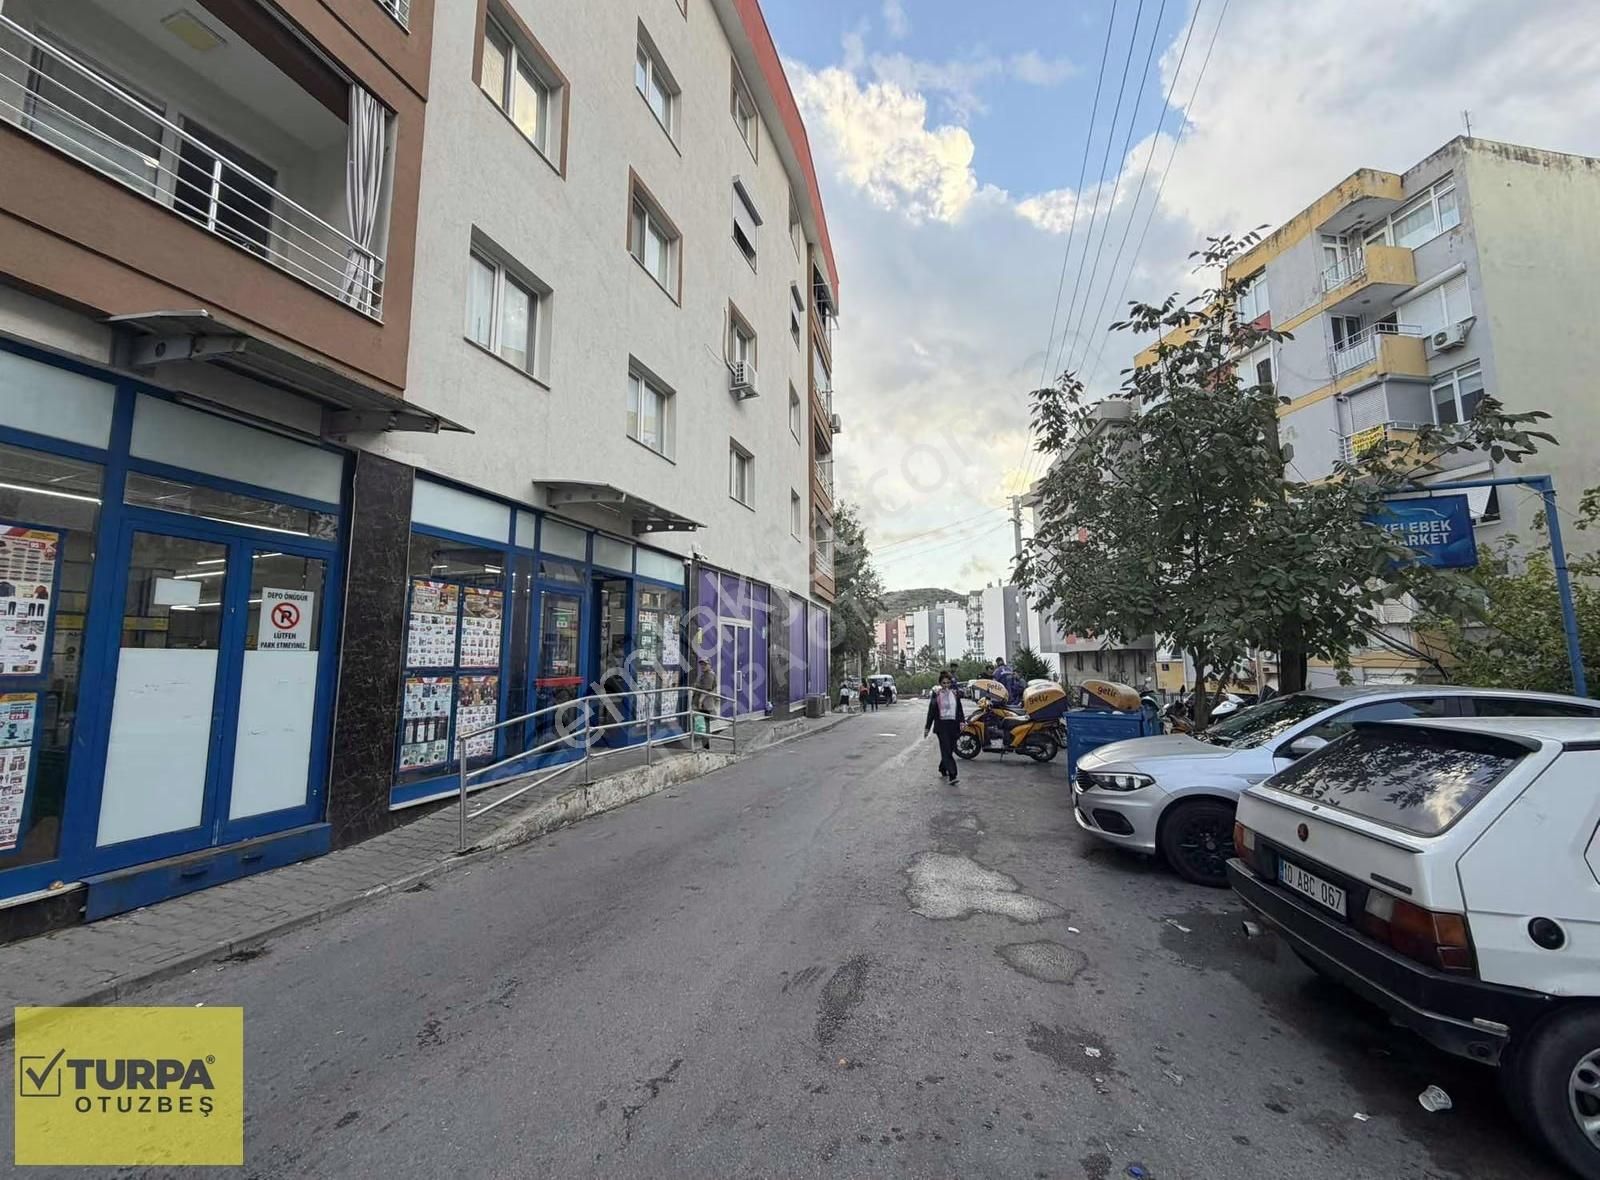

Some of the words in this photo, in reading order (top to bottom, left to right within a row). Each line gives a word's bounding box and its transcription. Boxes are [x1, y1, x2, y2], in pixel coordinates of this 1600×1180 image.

[1390, 532, 1450, 546] ARKET
[267, 592, 283, 600] DEPO
[273, 631, 297, 639] LÜTFEN
[1097, 685, 1117, 698] getir
[1028, 693, 1049, 705] getir
[1284, 863, 1292, 884] 10
[1298, 870, 1315, 896] ABC
[1321, 884, 1343, 910] 067
